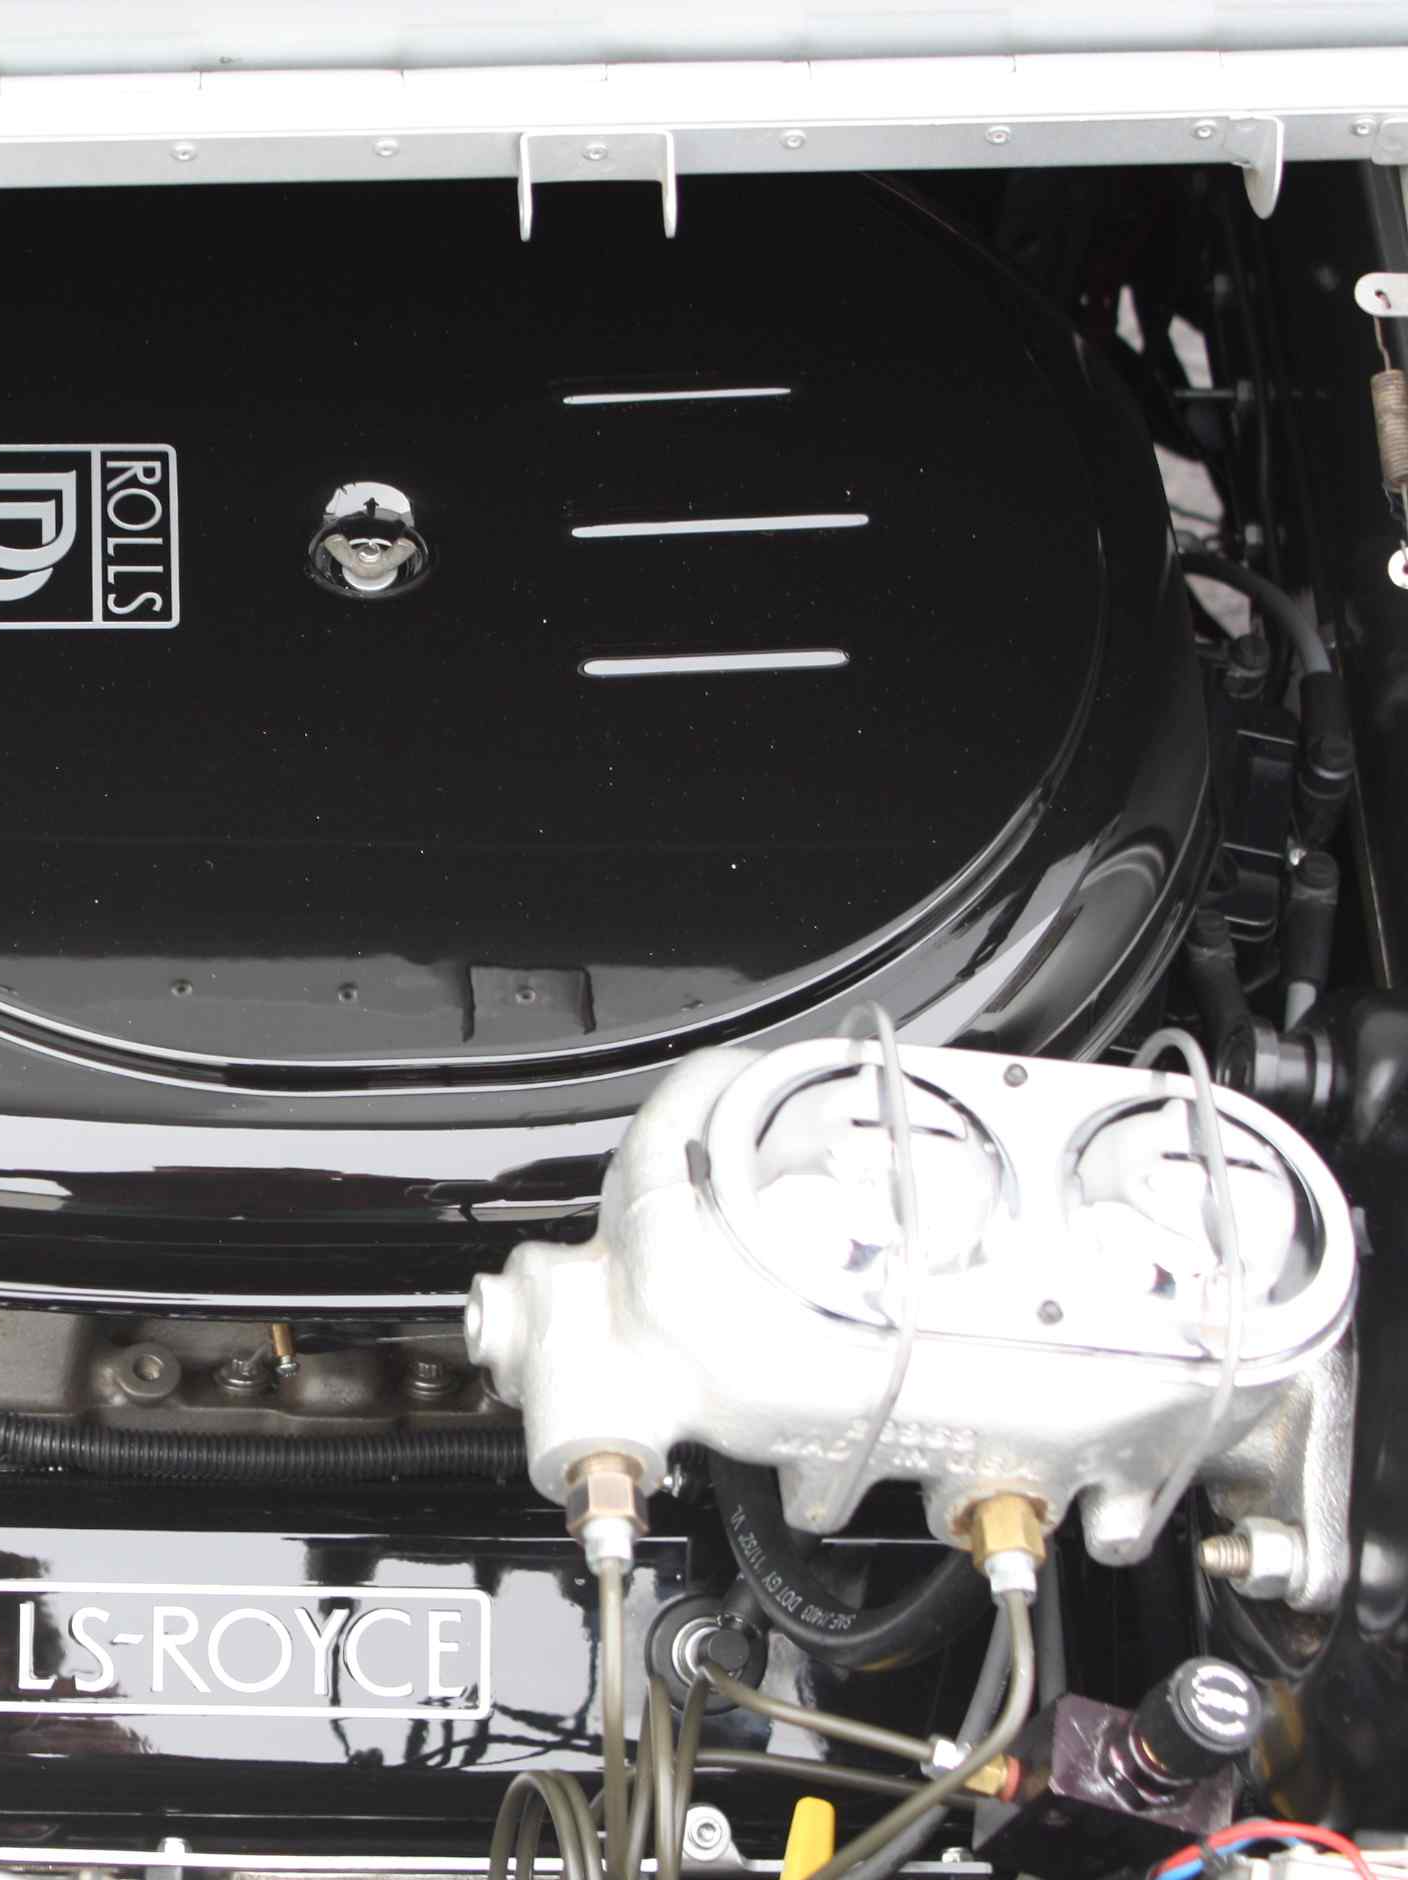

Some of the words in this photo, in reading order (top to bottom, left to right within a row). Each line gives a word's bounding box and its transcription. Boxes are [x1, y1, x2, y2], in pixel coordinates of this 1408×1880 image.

[106, 460, 163, 615] ROLLS
[761, 1570, 783, 1592] GY
[776, 1586, 803, 1613] DOT
